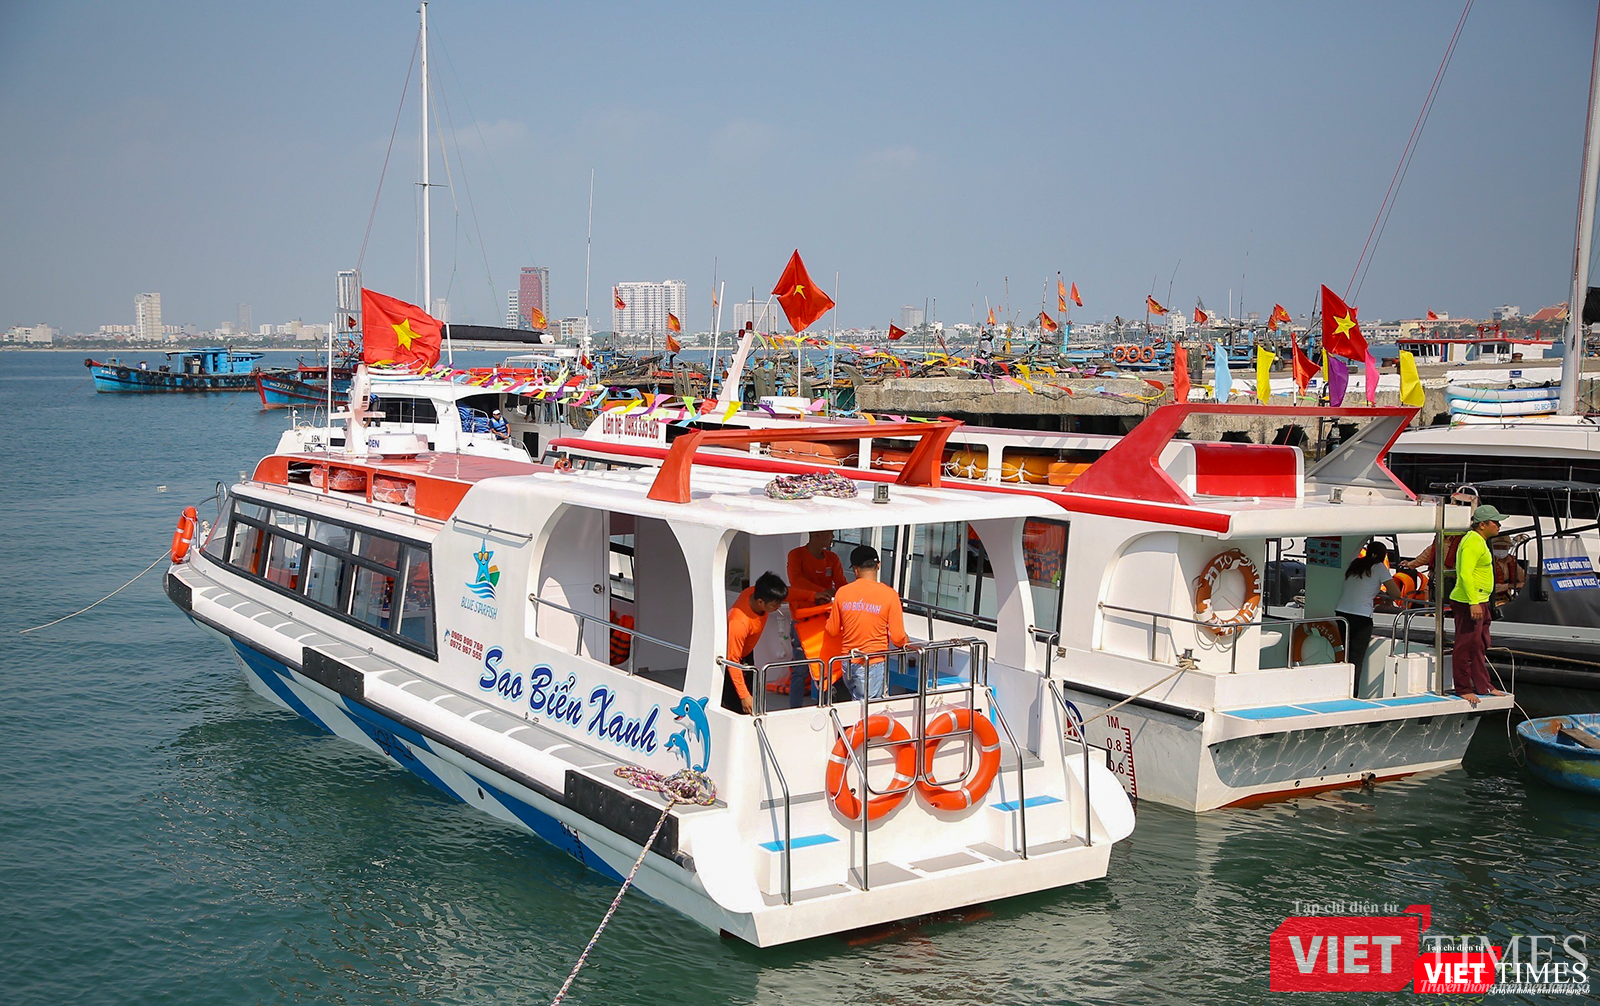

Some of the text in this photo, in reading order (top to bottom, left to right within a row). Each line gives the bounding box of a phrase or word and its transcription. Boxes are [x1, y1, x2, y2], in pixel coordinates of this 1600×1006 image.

[461, 596, 475, 611] BLUE
[479, 648, 659, 752] Sao Biển Xanh
[1106, 737, 1122, 751] 0.8
